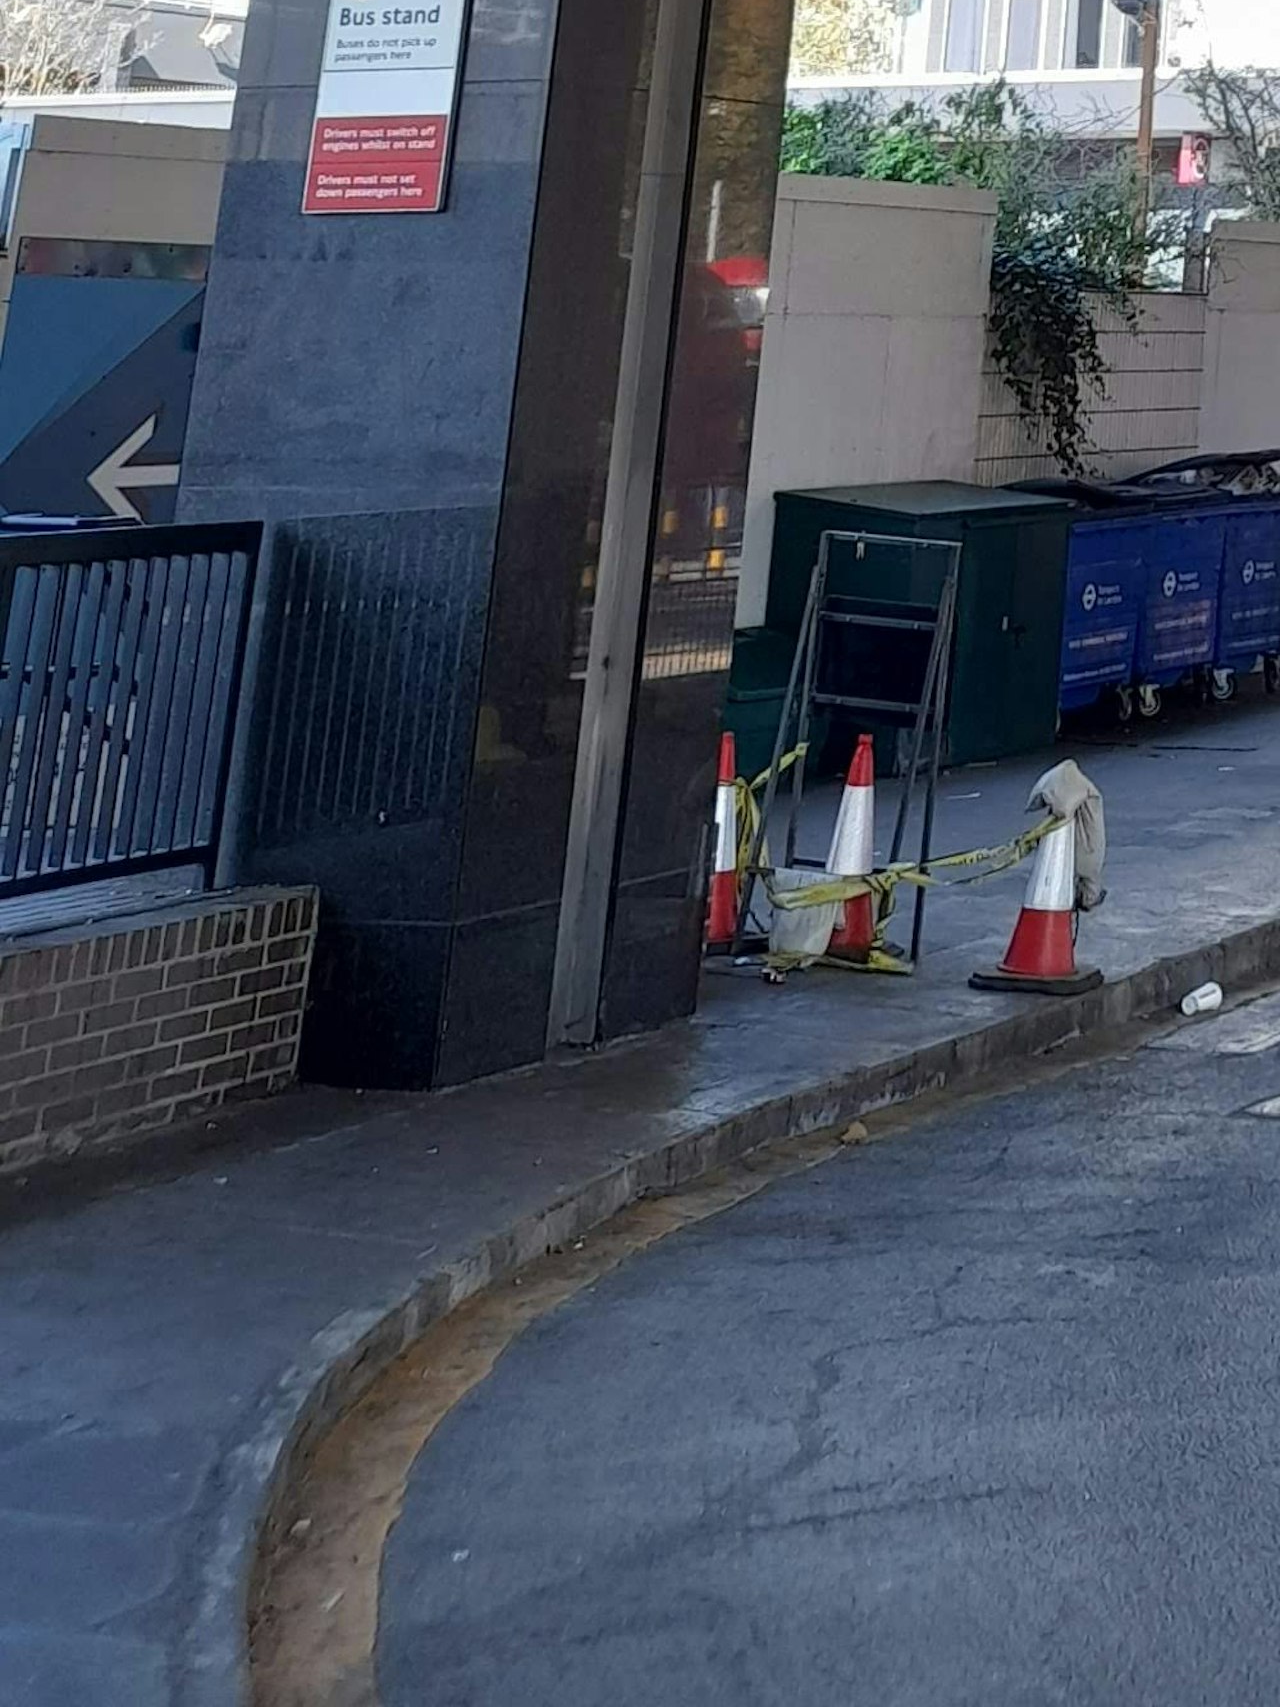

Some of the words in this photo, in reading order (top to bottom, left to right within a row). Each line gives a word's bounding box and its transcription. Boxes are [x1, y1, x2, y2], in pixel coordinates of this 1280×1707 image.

[339, 7, 376, 27] Bus
[381, 4, 441, 25] stand
[336, 38, 364, 49] Buses
[366, 37, 380, 48] do
[382, 37, 399, 48] not
[400, 37, 421, 49] pick
[423, 37, 437, 48] up
[334, 51, 388, 63] passengers
[390, 50, 412, 60] here
[323, 127, 357, 139] Drivers
[359, 127, 384, 138] must
[420, 124, 436, 137] off
[317, 174, 351, 185] Drivers
[353, 174, 378, 185] must
[380, 175, 397, 185] not
